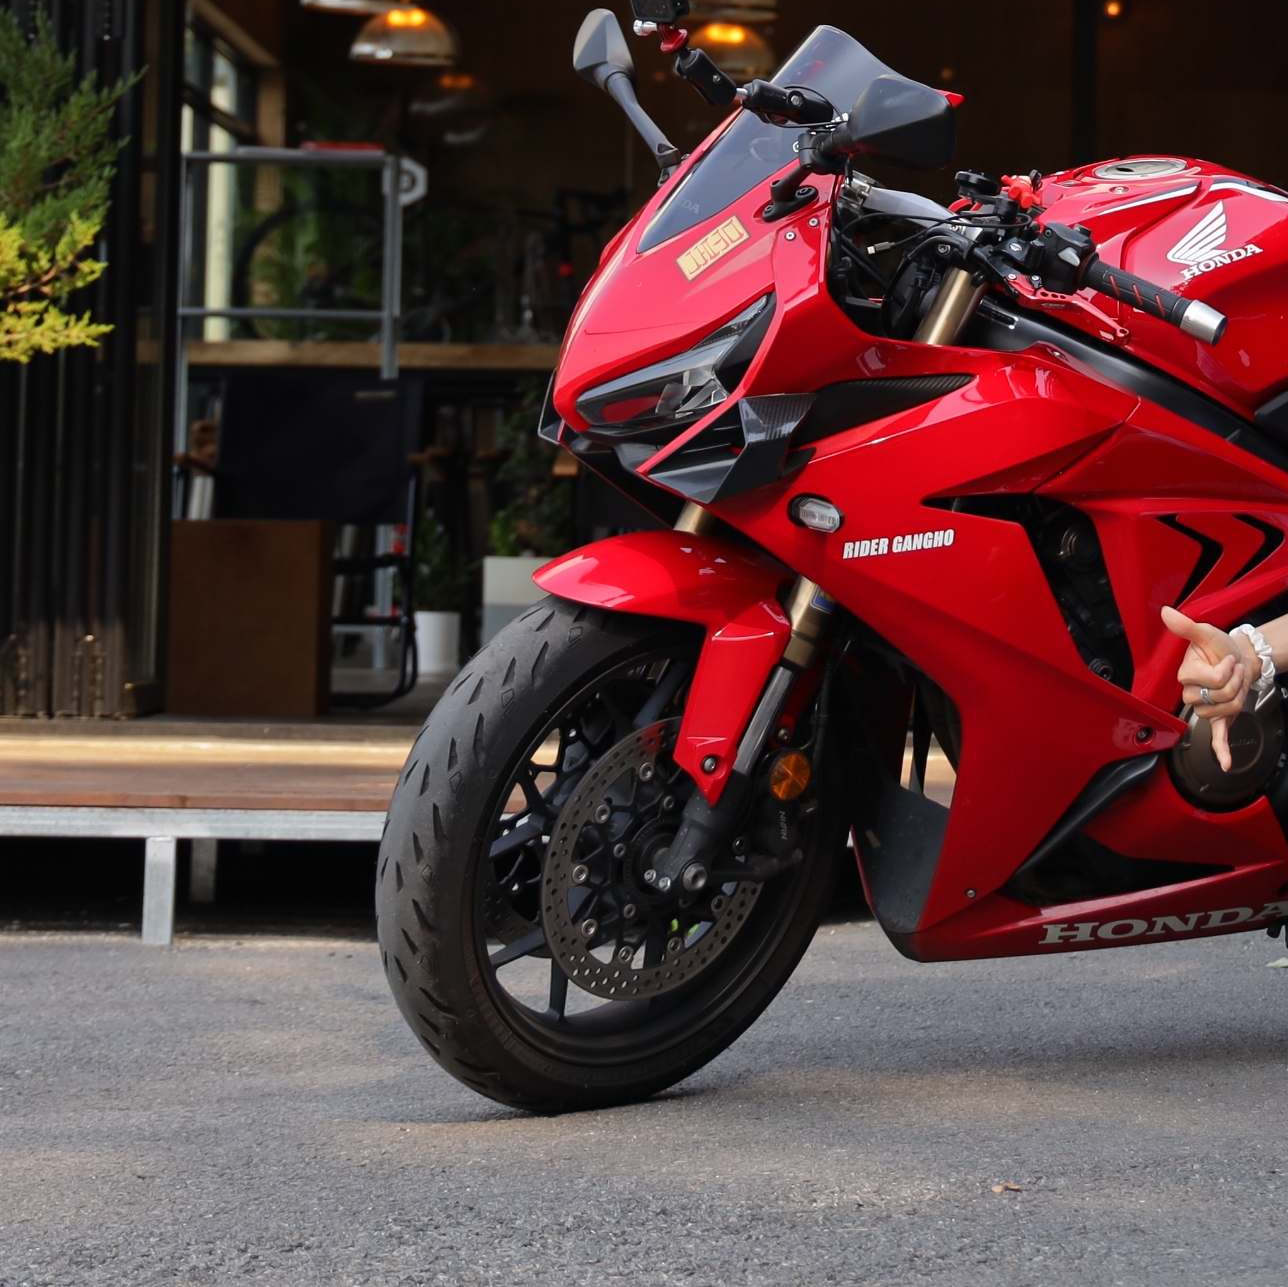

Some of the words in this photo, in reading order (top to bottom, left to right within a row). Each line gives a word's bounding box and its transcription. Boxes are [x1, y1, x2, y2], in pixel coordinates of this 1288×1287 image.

[1179, 243, 1264, 280] HONDA
[842, 537, 889, 560] RIDER
[891, 529, 955, 554] GANGHO
